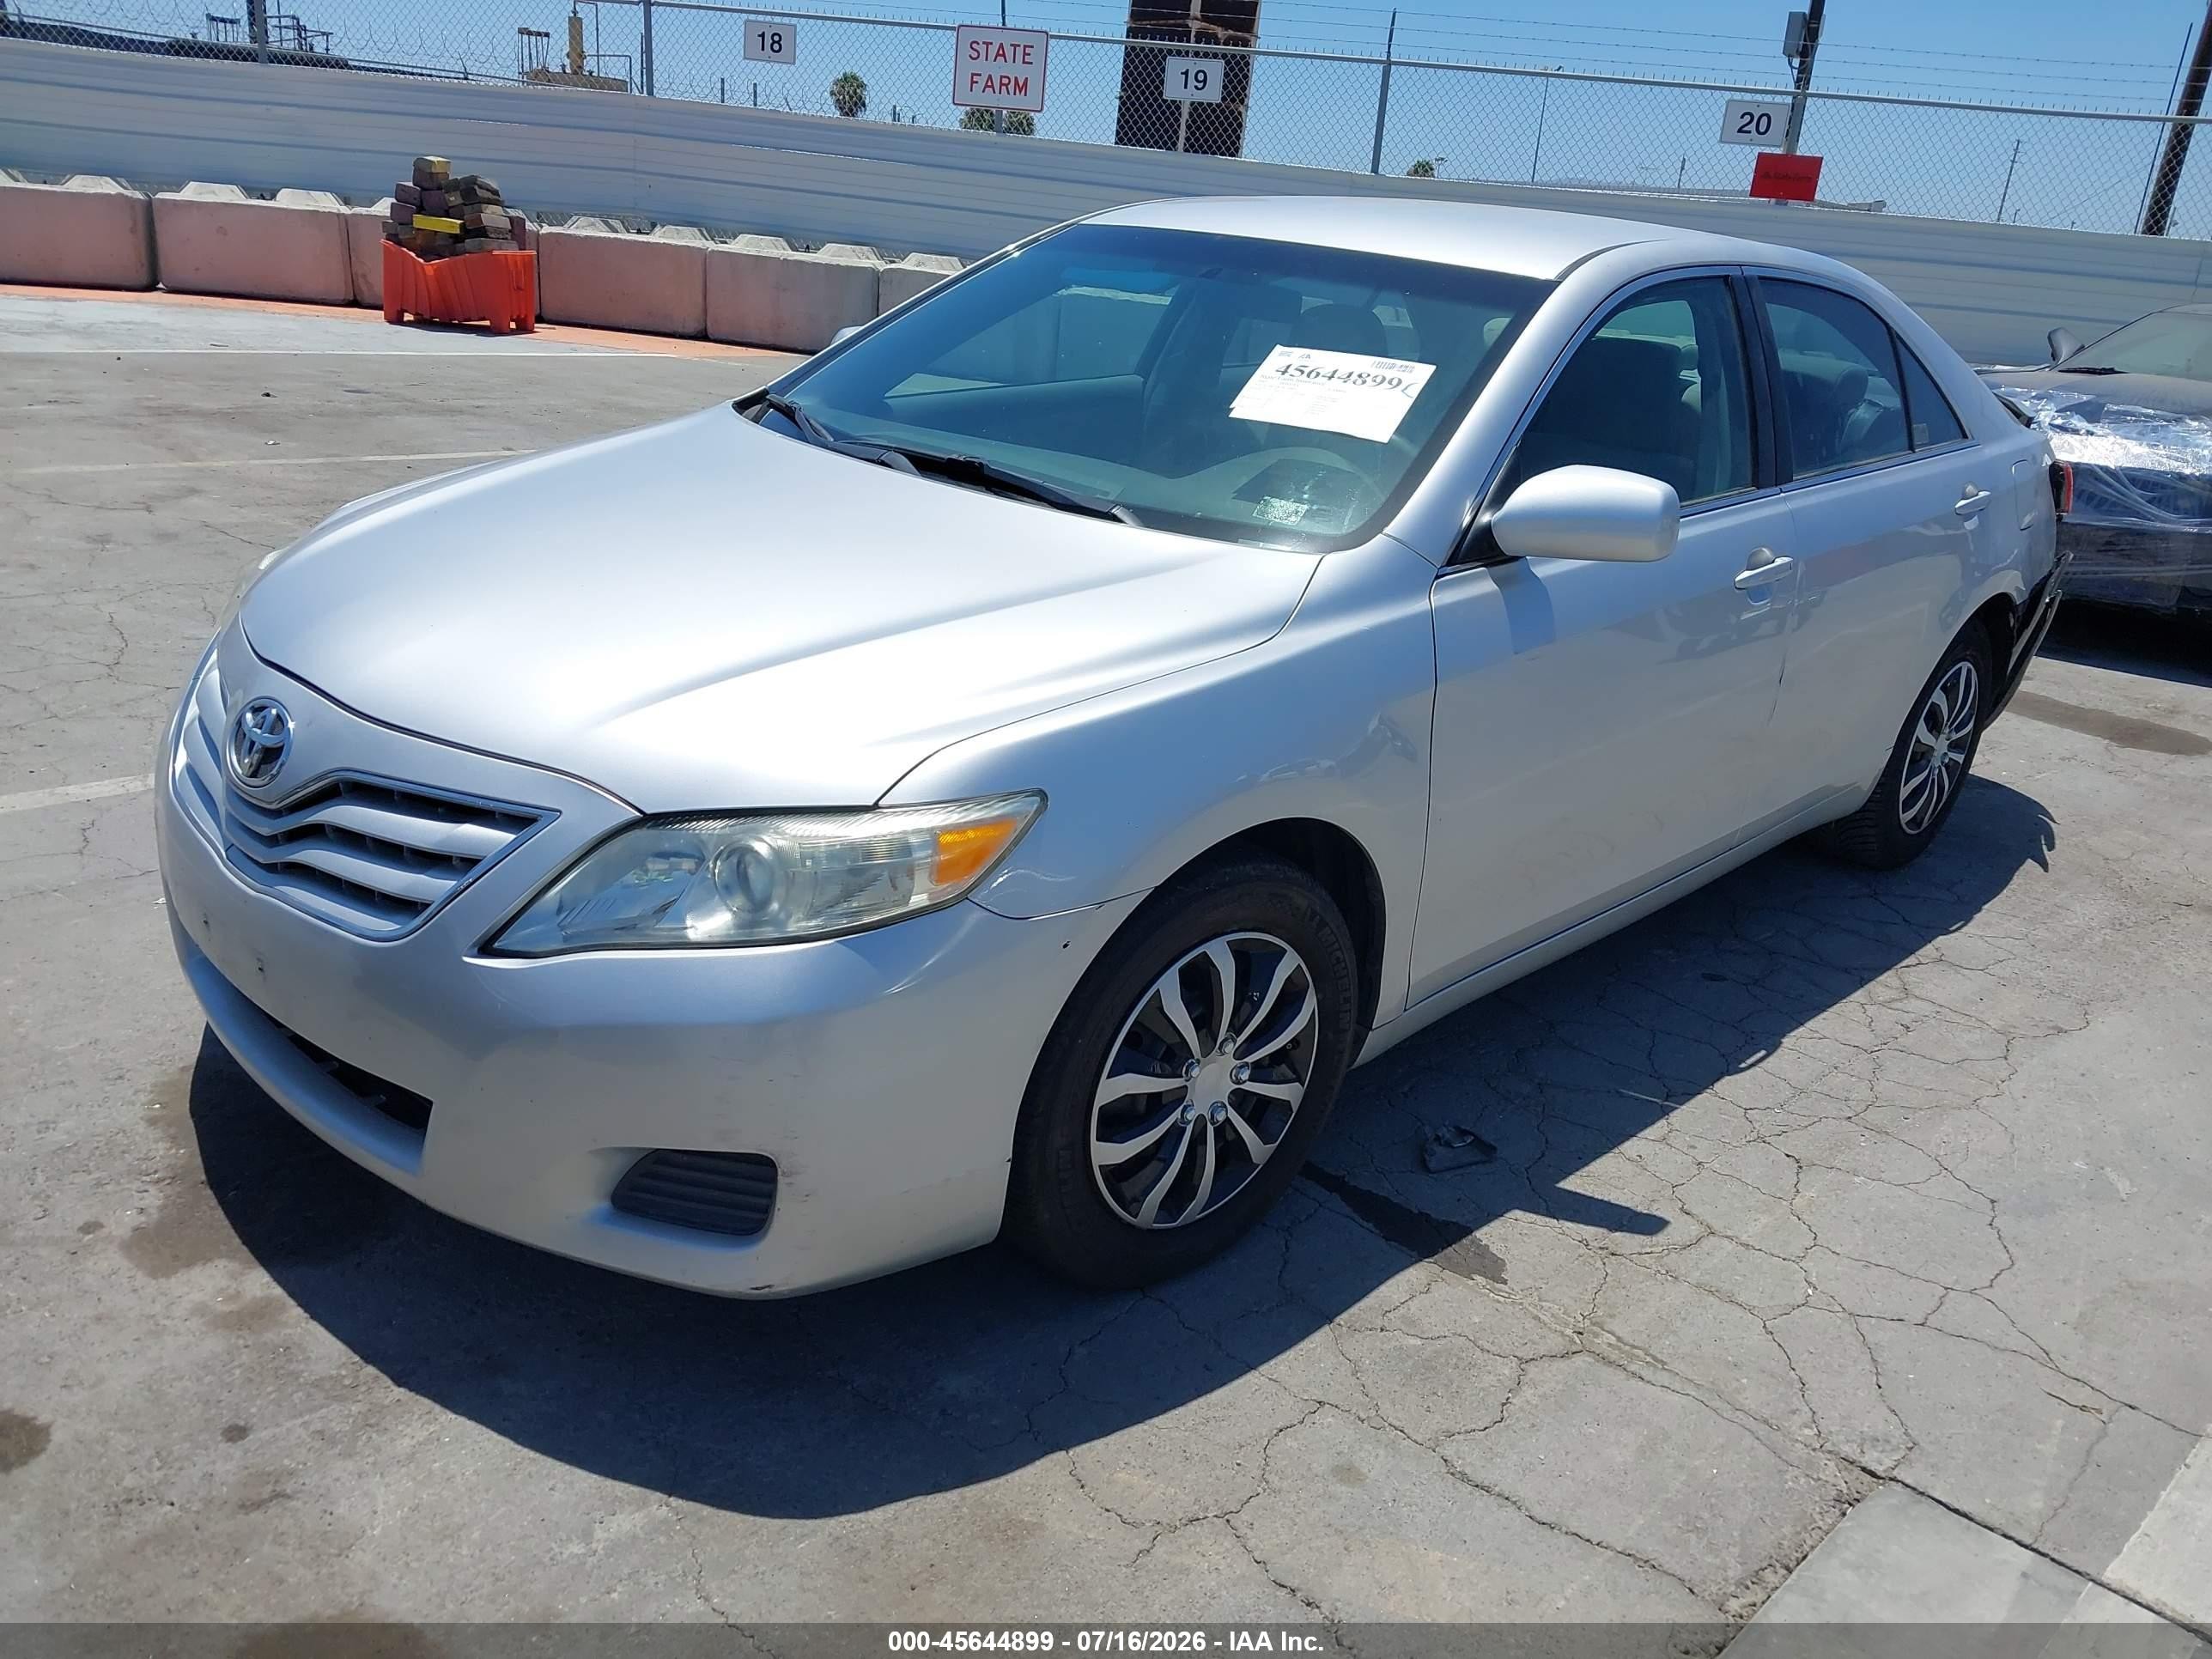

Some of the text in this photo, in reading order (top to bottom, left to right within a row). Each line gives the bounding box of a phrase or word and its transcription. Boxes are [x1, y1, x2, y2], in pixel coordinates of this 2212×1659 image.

[757, 30, 783, 53] 18
[968, 40, 1035, 65] STATE
[969, 71, 1029, 97] FARM
[1180, 68, 1208, 91] 19
[1736, 111, 1772, 136] 20
[1275, 362, 1402, 391] 45644899
[1320, 925, 1352, 1029] MICHELIN
